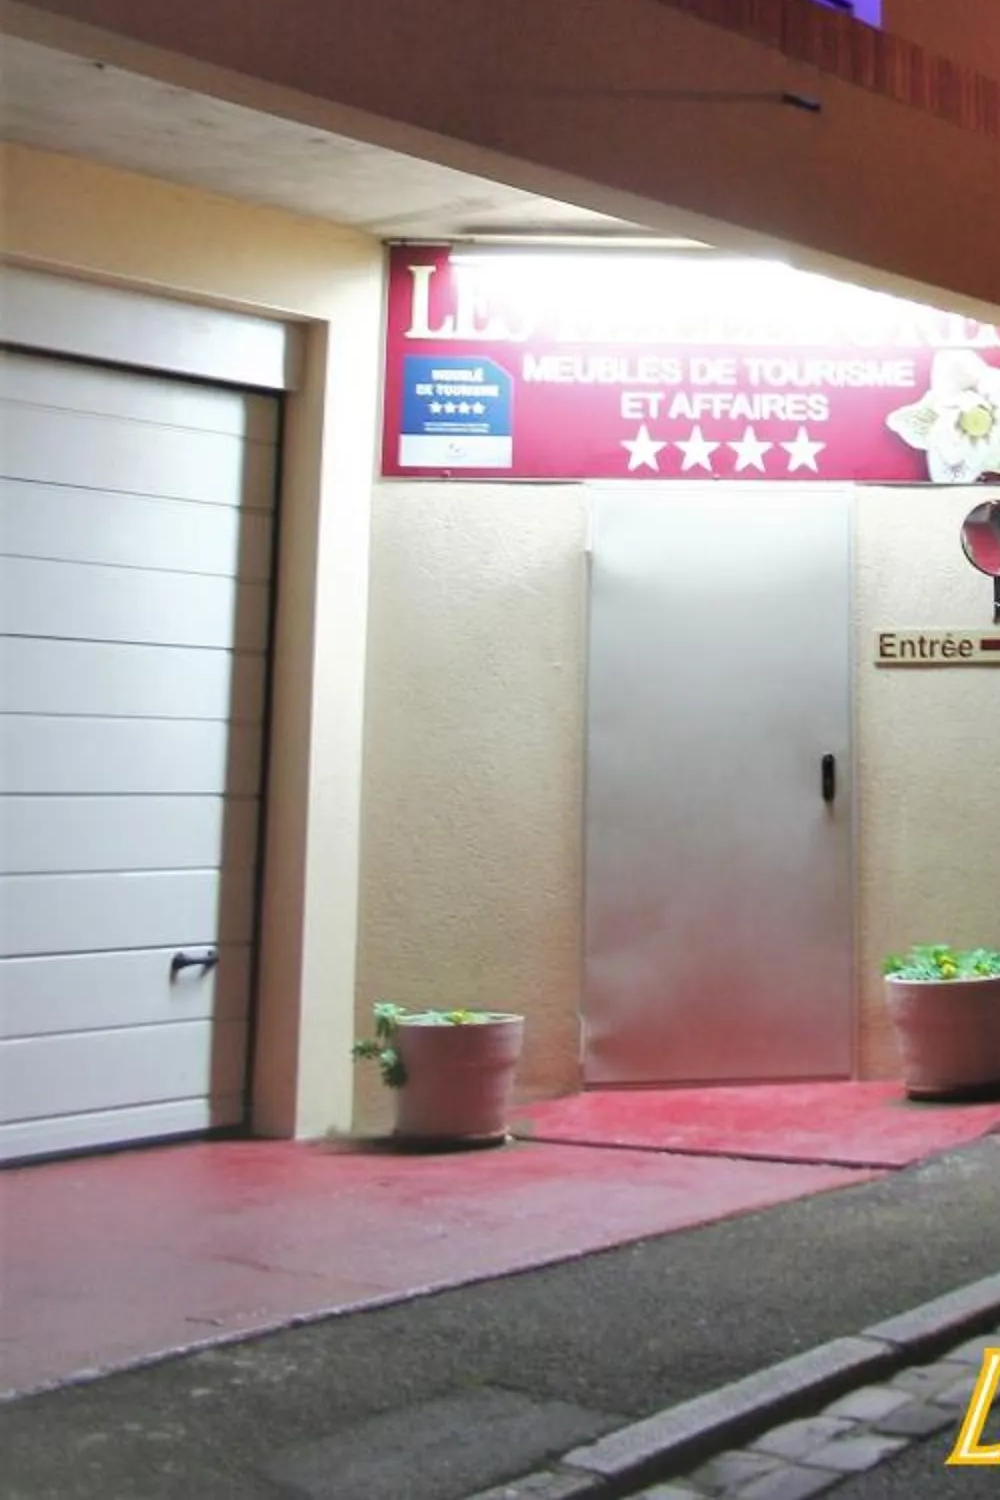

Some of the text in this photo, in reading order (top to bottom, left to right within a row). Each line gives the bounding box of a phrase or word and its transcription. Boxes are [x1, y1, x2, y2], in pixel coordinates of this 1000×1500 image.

[689, 357, 738, 385] DE
[743, 357, 915, 387] TOURISME
[621, 392, 829, 421] ET AFFAIRES
[879, 633, 974, 658] Entrée
